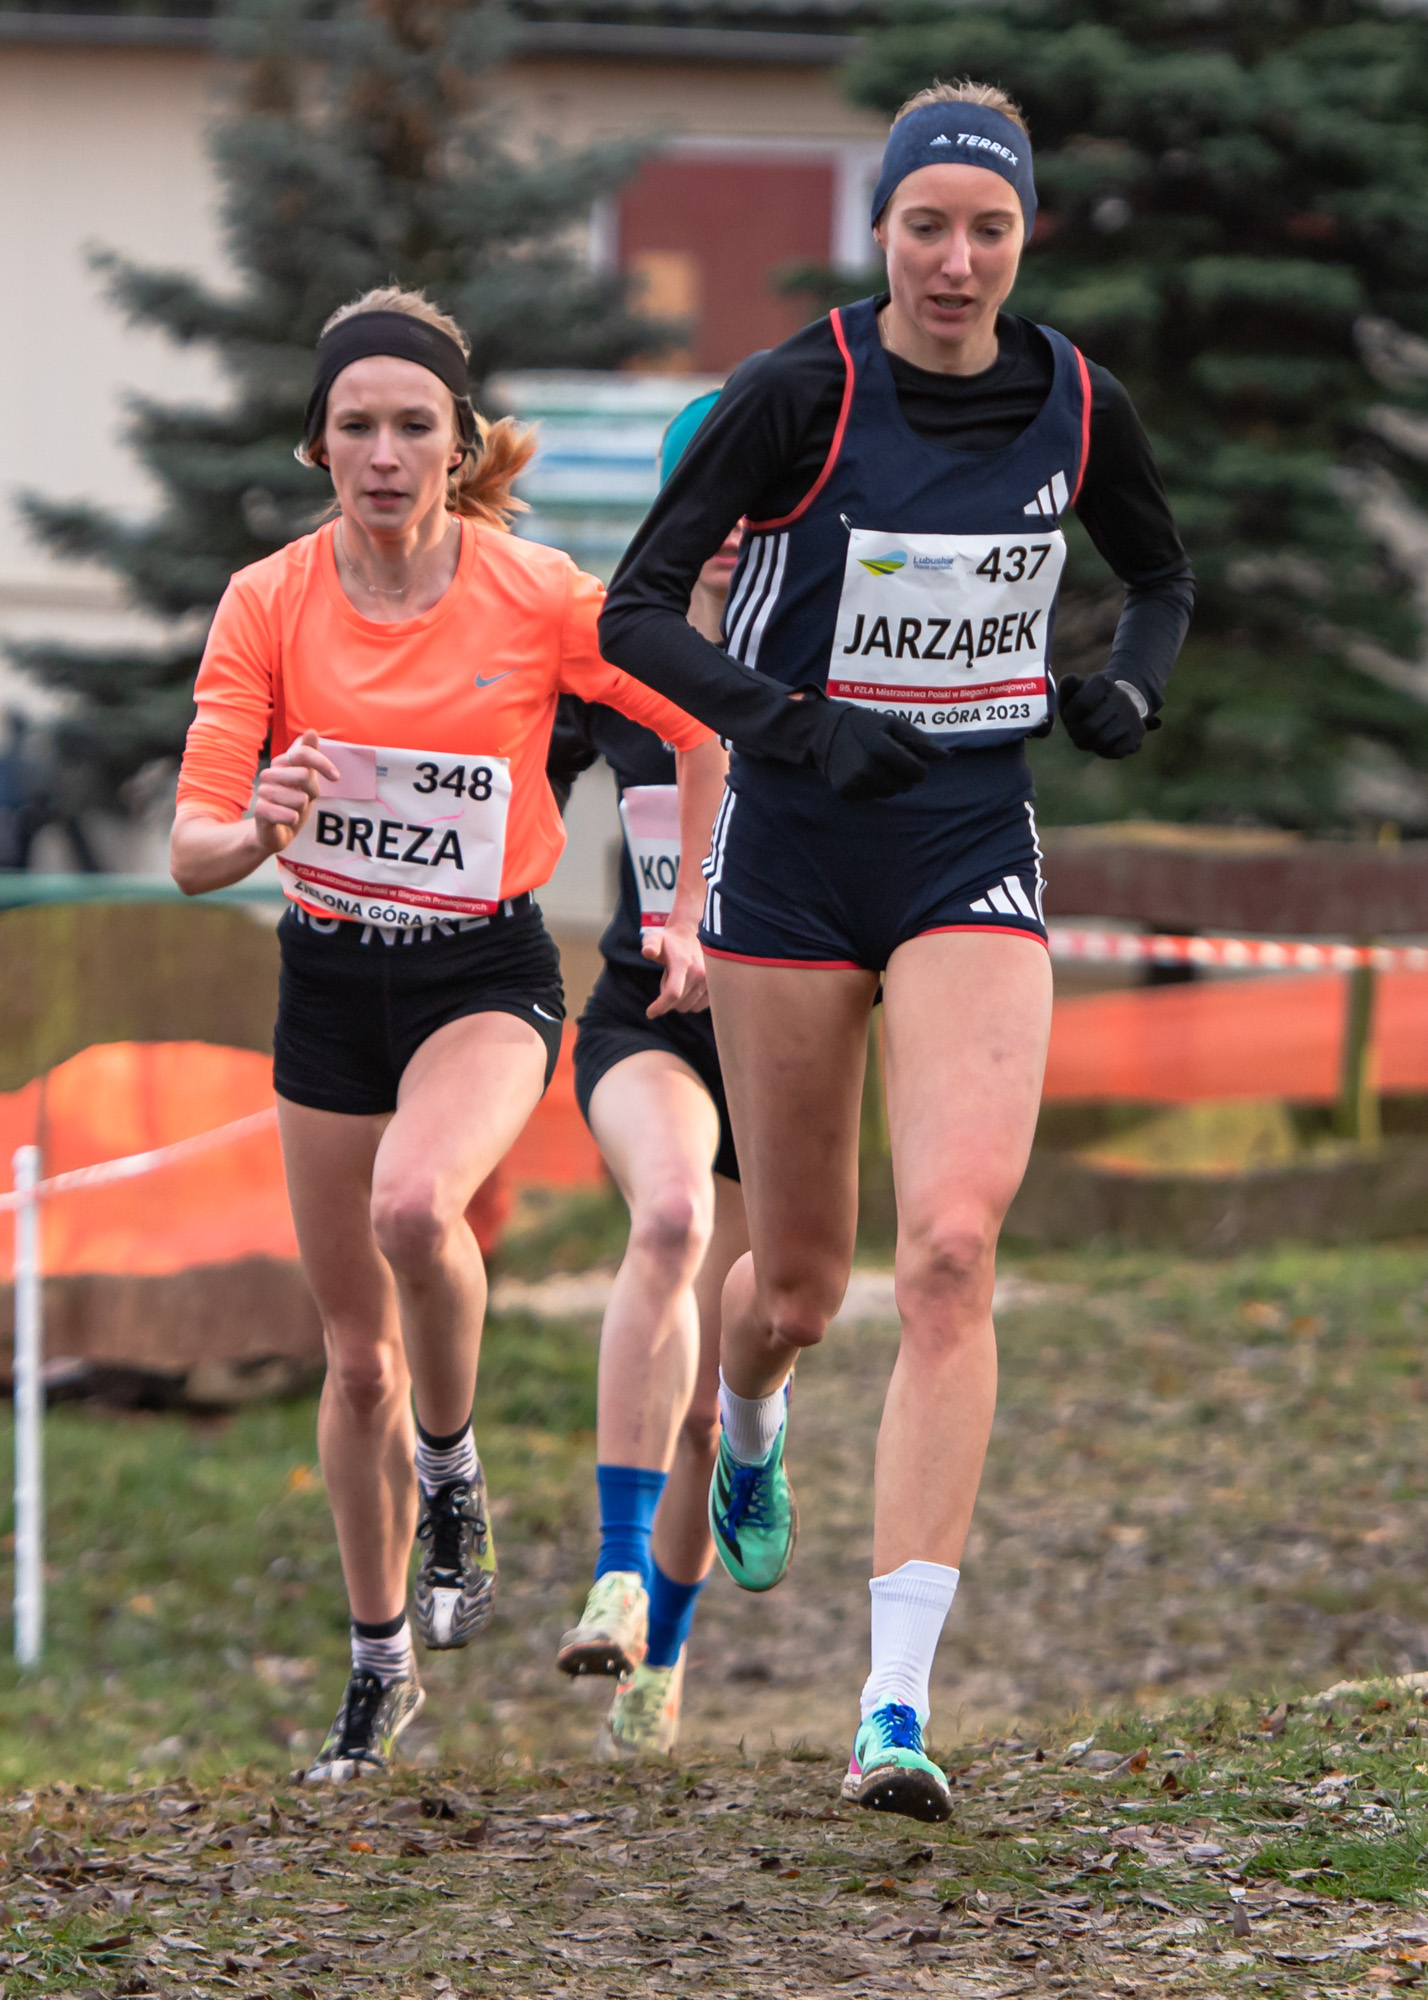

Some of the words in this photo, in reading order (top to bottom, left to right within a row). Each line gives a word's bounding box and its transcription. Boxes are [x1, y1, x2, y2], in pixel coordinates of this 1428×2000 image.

[956, 133, 1018, 167] TERREX
[975, 543, 1052, 584] 437
[842, 608, 1042, 669] JARZĄBEK
[853, 685, 875, 695] PZLA
[875, 687, 926, 699] Mistrzostwa
[927, 689, 951, 699] Polski
[952, 690, 959, 698] w
[931, 706, 982, 725] GÓRA
[985, 703, 1030, 721] 2023
[412, 761, 493, 802] 348
[315, 810, 465, 871] BREZA
[638, 855, 680, 891] KO
[368, 904, 424, 926] GÓRA
